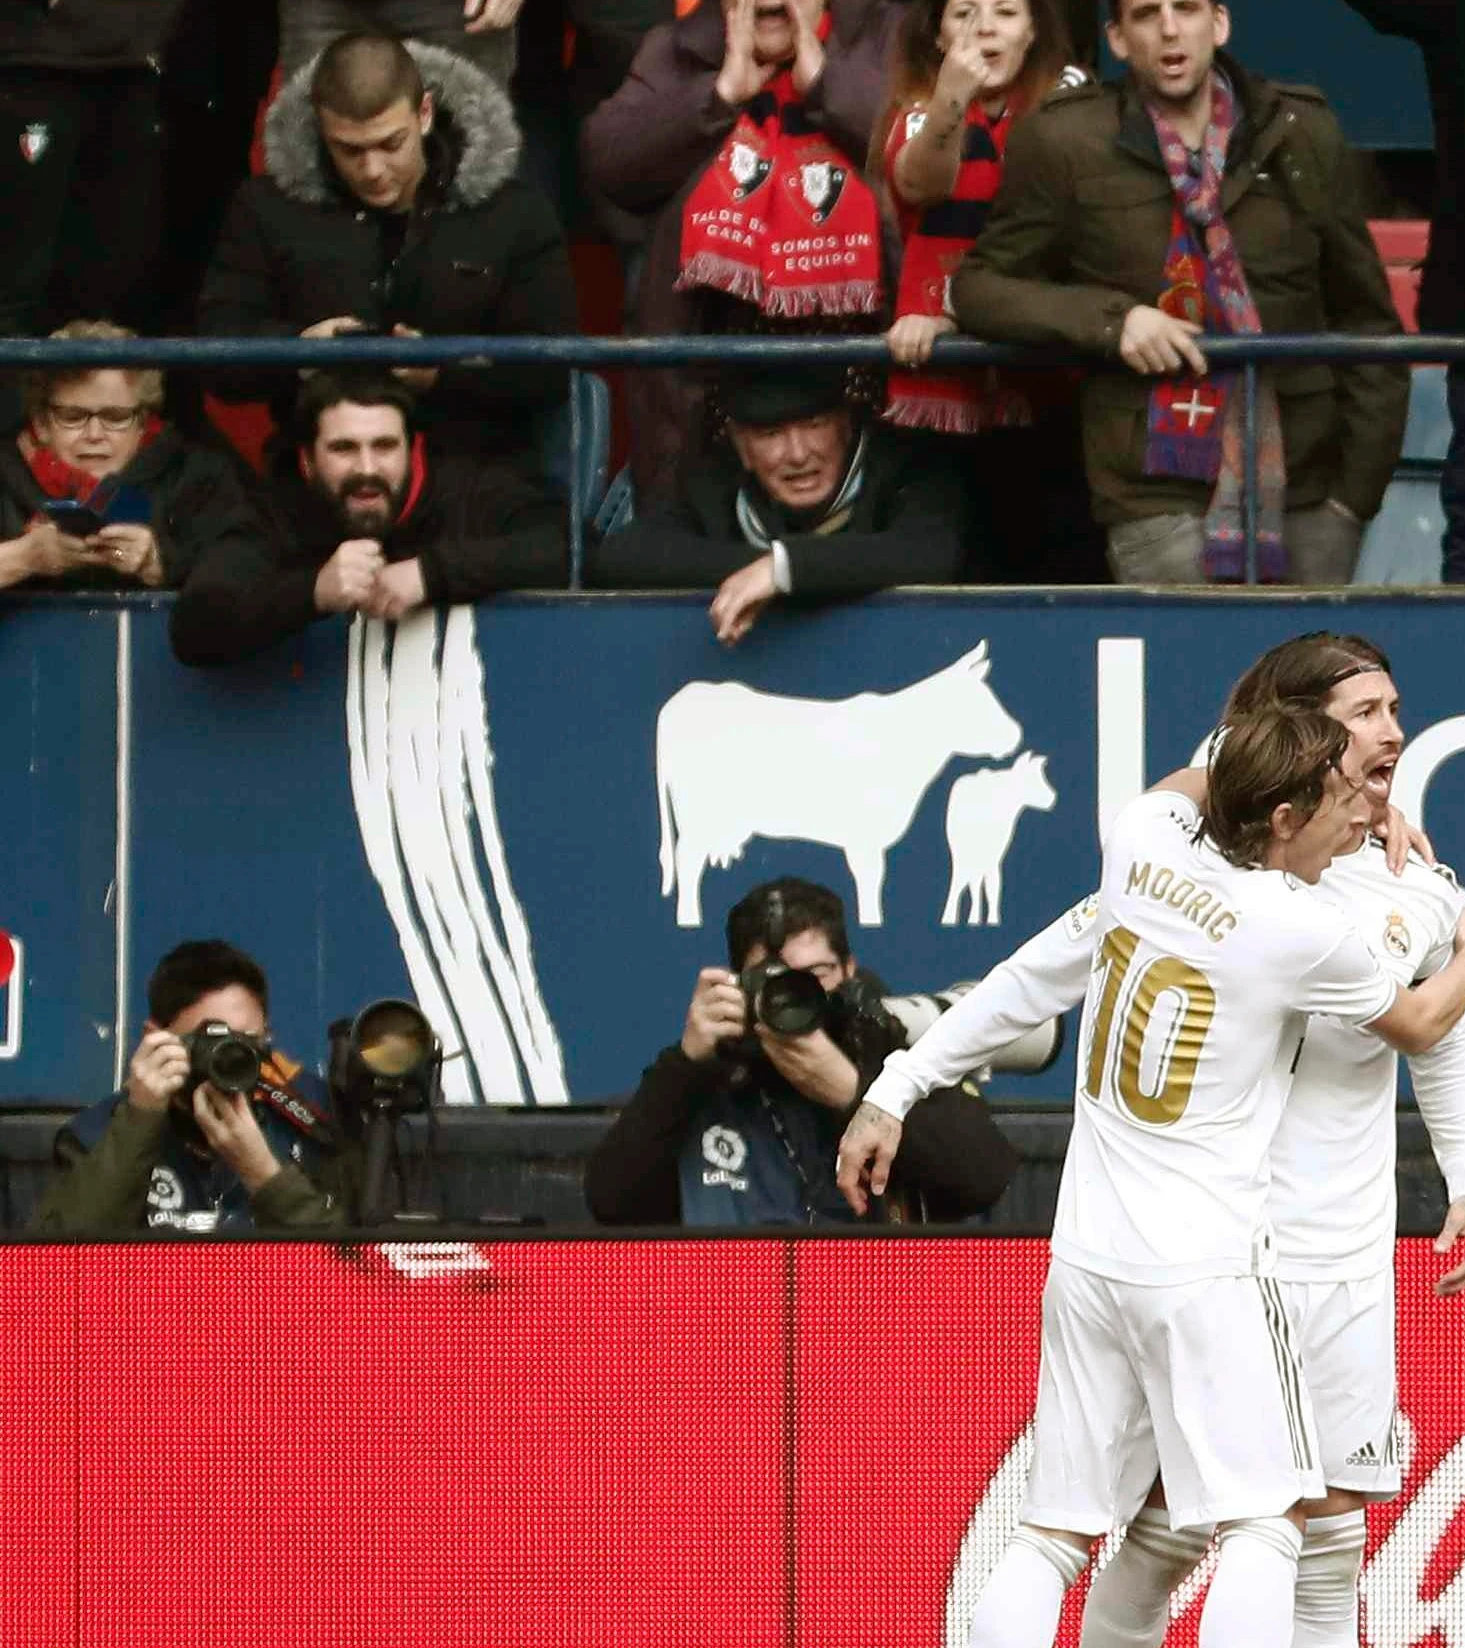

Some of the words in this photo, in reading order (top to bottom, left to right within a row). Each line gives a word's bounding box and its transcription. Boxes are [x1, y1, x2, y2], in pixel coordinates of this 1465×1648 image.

[691, 208, 743, 226] TALDE
[706, 223, 754, 247] GARA
[770, 235, 837, 256] SOMOS
[844, 233, 870, 248] UN
[784, 251, 857, 272] EQUIPO
[1124, 860, 1243, 944] MODRIĆ
[1080, 925, 1216, 1128] 10
